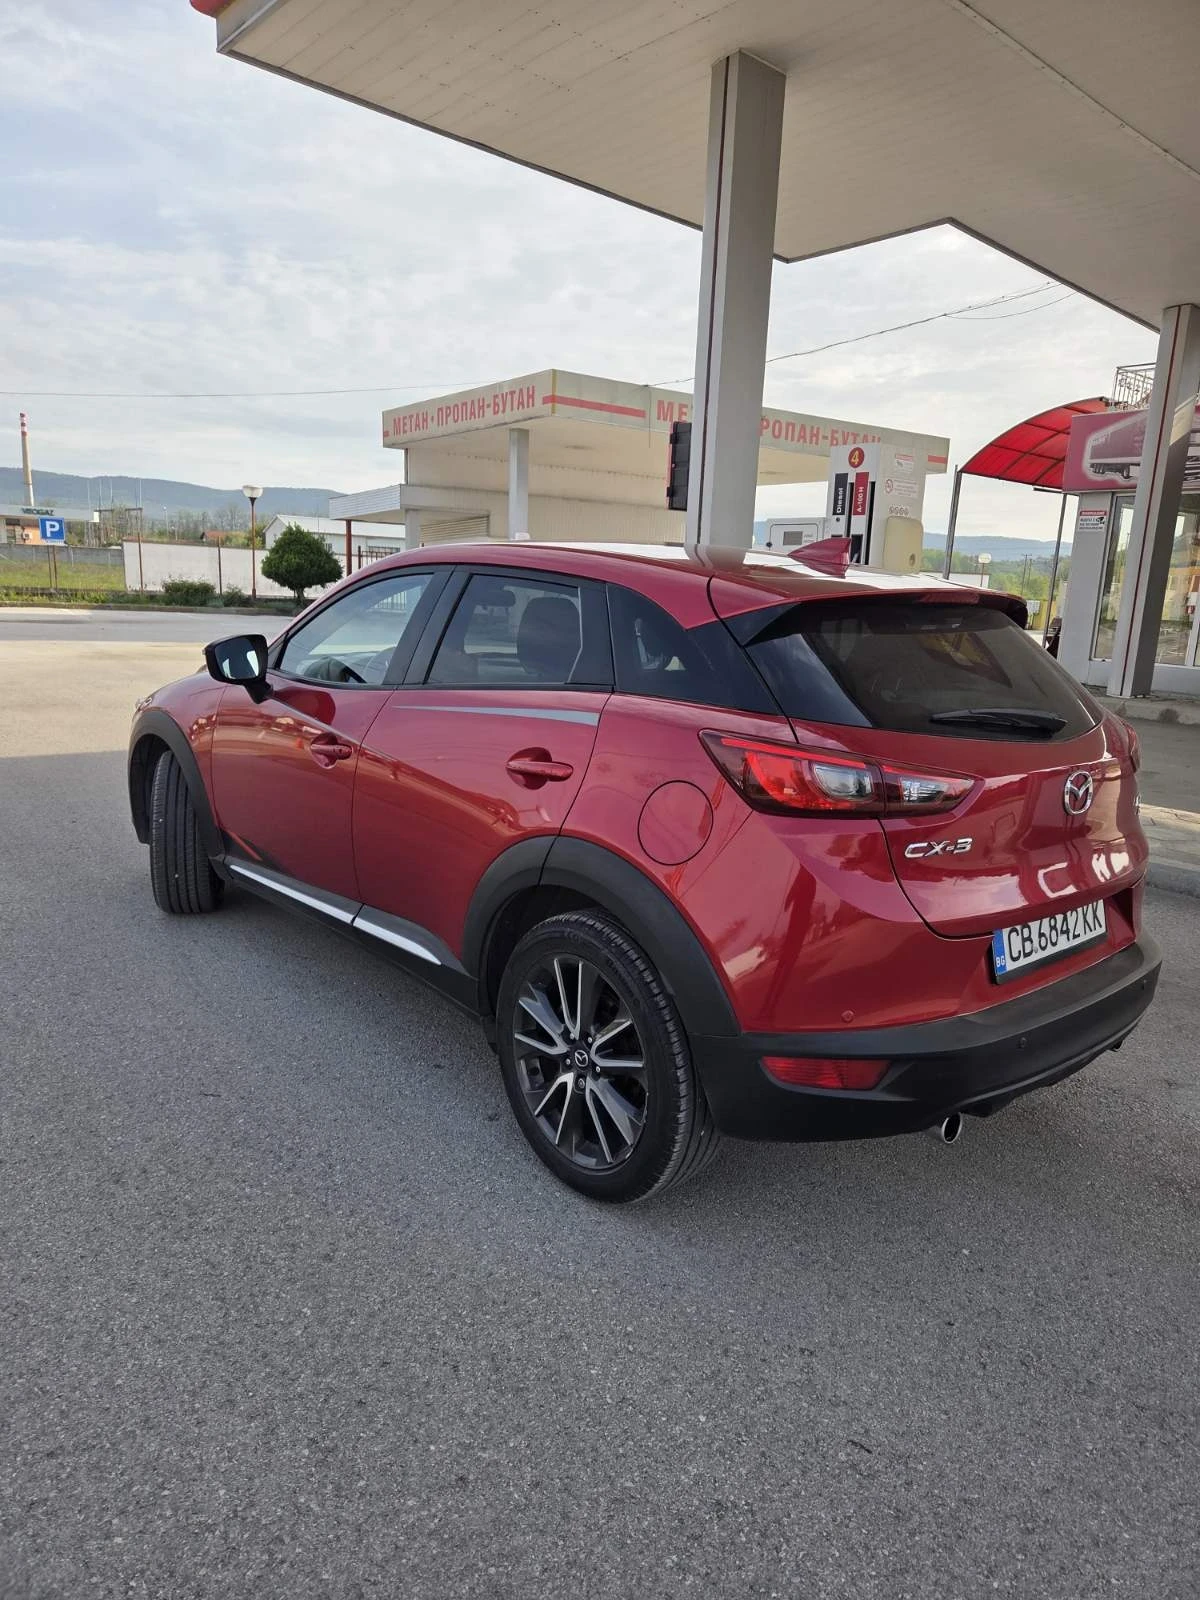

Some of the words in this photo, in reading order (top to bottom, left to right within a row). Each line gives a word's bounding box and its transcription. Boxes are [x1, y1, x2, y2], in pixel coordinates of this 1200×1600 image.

[393, 410, 429, 437] МЕТАН
[852, 450, 859, 465] 4
[45, 520, 60, 538] P
[904, 838, 973, 858] CX-3
[995, 955, 1006, 968] BG
